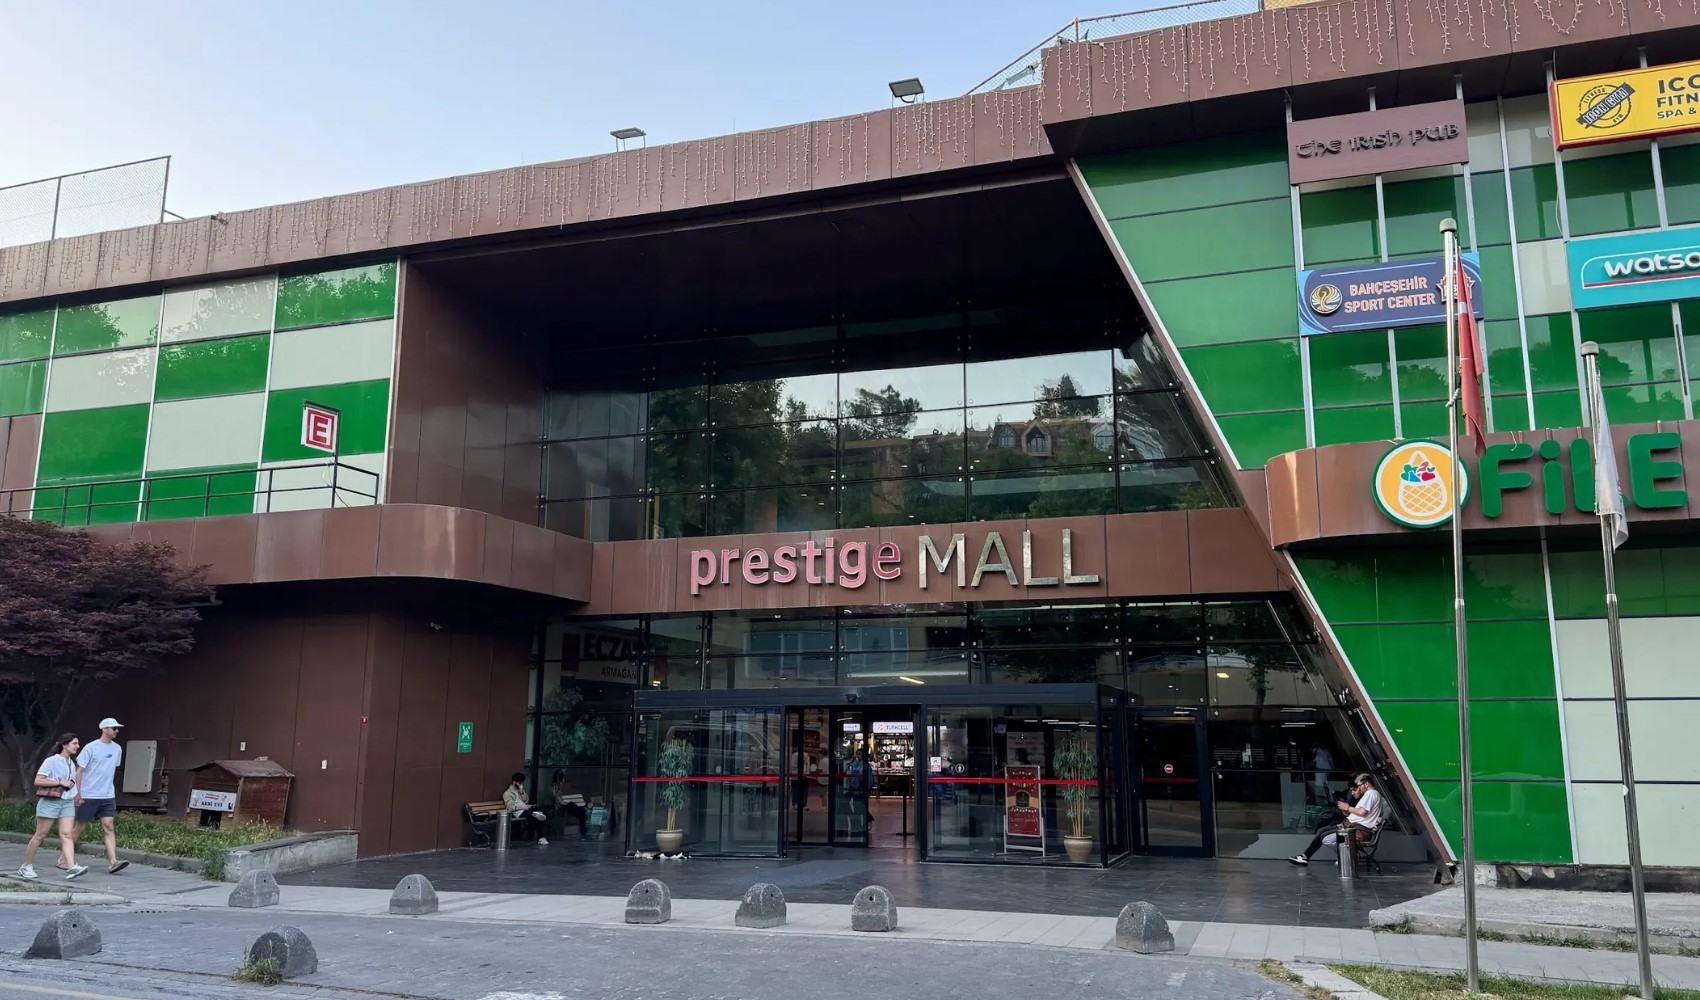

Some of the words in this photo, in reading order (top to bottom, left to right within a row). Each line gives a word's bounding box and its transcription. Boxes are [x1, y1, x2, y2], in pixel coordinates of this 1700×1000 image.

[1657, 109, 1683, 119] SPA
[1688, 107, 1697, 115] &
[1349, 275, 1428, 297] BAHÇEŞEHİR
[1344, 298, 1385, 314] SPORT
[1387, 292, 1437, 309] CENTER
[690, 537, 901, 595] prestige
[918, 529, 1101, 589] MALL
